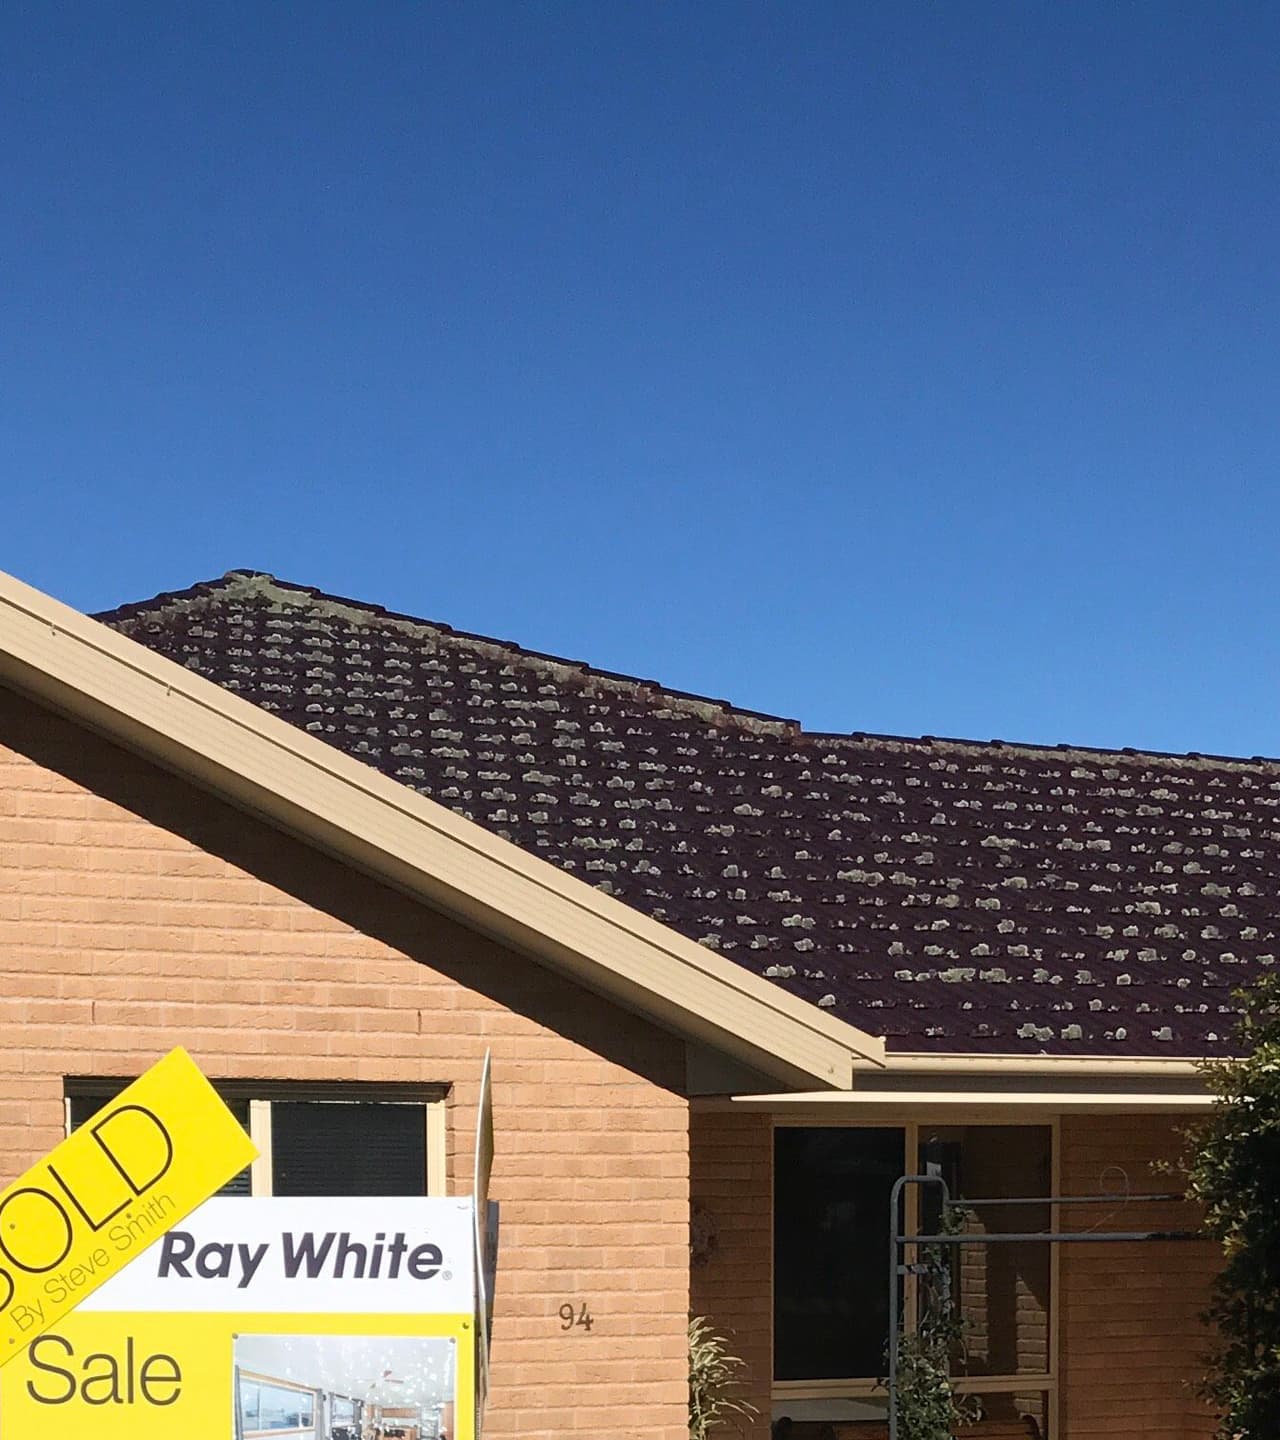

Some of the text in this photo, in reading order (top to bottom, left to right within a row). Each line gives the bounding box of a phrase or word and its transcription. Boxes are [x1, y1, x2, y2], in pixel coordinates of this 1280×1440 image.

[9, 1194, 177, 1332] By Steve Smith
[157, 1231, 443, 1289] Ray White
[558, 1302, 594, 1331] 94
[26, 1335, 182, 1406] Sale
